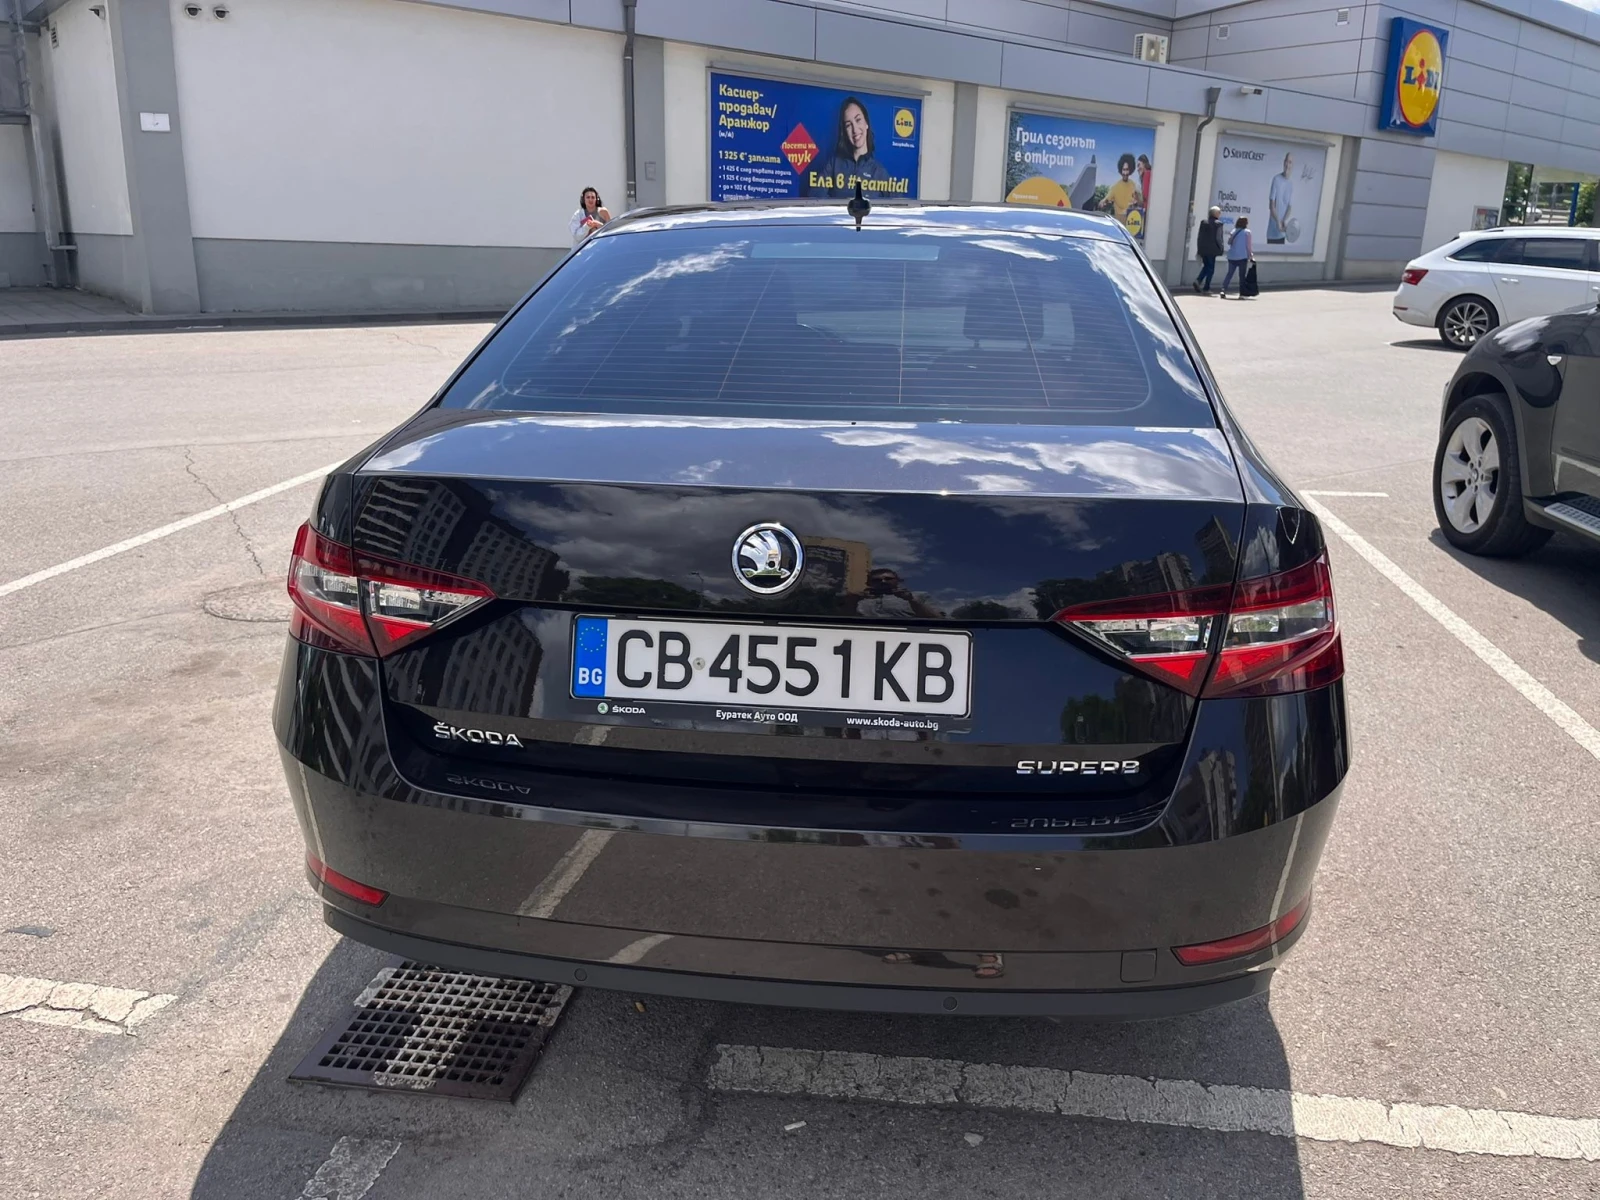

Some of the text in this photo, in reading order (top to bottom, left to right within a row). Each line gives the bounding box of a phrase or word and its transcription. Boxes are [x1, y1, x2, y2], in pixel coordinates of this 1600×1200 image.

[719, 84, 764, 102] Касиер-
[719, 101, 777, 118] продавач/
[719, 114, 770, 133] Аранжор
[1016, 127, 1095, 150] Грил сезонът
[748, 154, 781, 163] заплата
[788, 150, 811, 166] тук
[1015, 149, 1074, 169] е открит
[809, 171, 833, 188] Ела
[836, 173, 844, 189] в
[1218, 190, 1237, 203] Прави
[617, 629, 955, 703] CB 4551 KB
[578, 667, 603, 686] BG
[612, 706, 646, 714] ŠKODA
[715, 709, 799, 723] Еуратек Ауто ООД
[846, 717, 939, 731] www.skoda-auto.bg
[433, 721, 524, 748] ŠKODA
[1016, 760, 1140, 775] SUPERB
